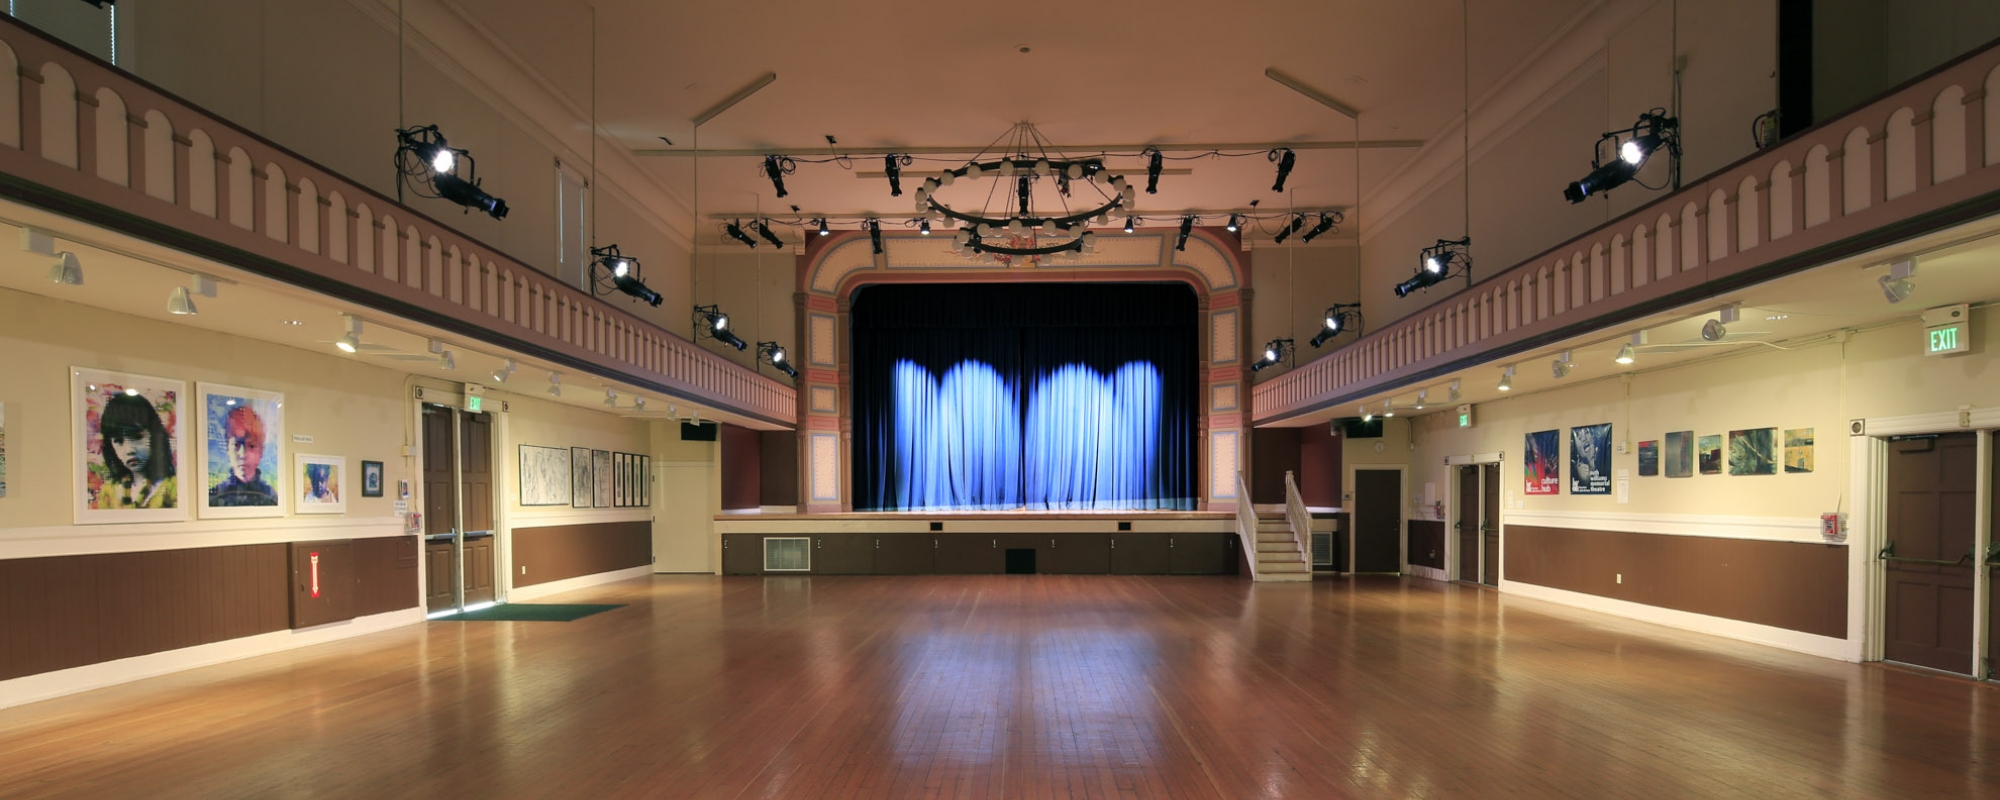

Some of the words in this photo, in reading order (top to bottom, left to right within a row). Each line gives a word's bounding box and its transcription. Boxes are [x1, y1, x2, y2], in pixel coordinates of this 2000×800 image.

[1930, 327, 1958, 352] EXIT
[470, 396, 481, 411] EXIT
[1541, 484, 1552, 492] hub
